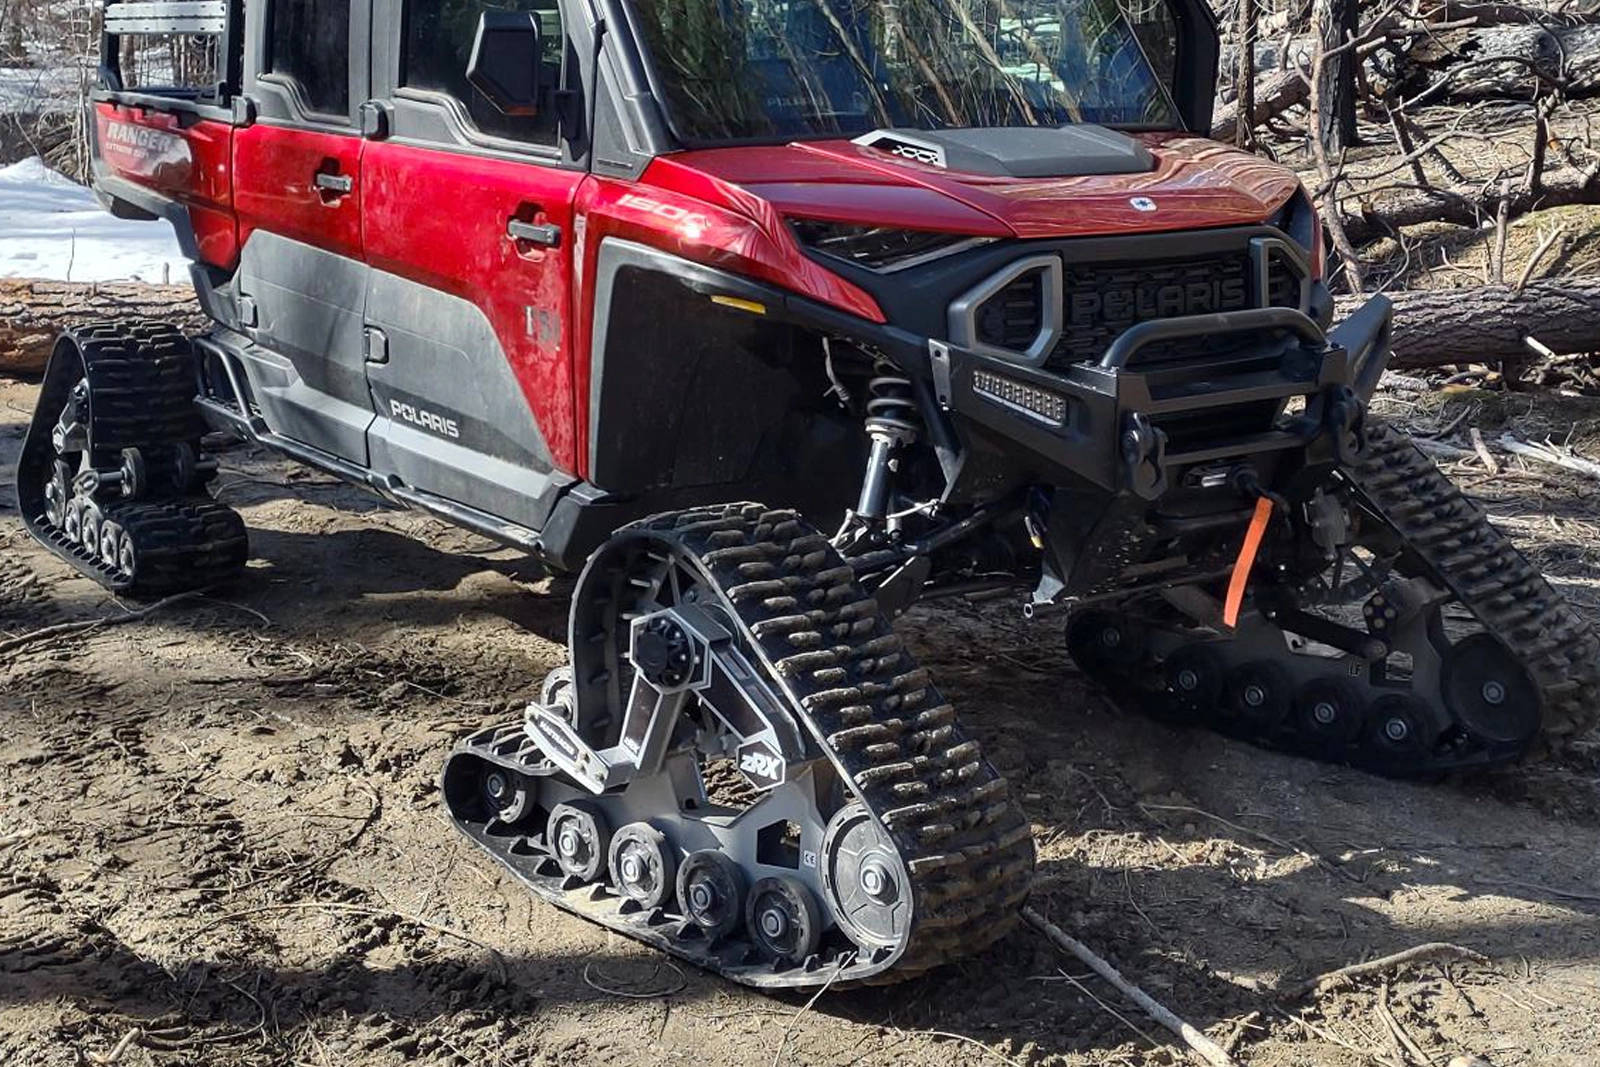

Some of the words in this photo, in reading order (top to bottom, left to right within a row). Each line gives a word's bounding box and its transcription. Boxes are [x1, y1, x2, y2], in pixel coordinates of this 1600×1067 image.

[107, 122, 171, 151] RANGER
[1072, 278, 1246, 327] POLARIS
[389, 399, 459, 438] POLARIS
[804, 853, 816, 865] CE
